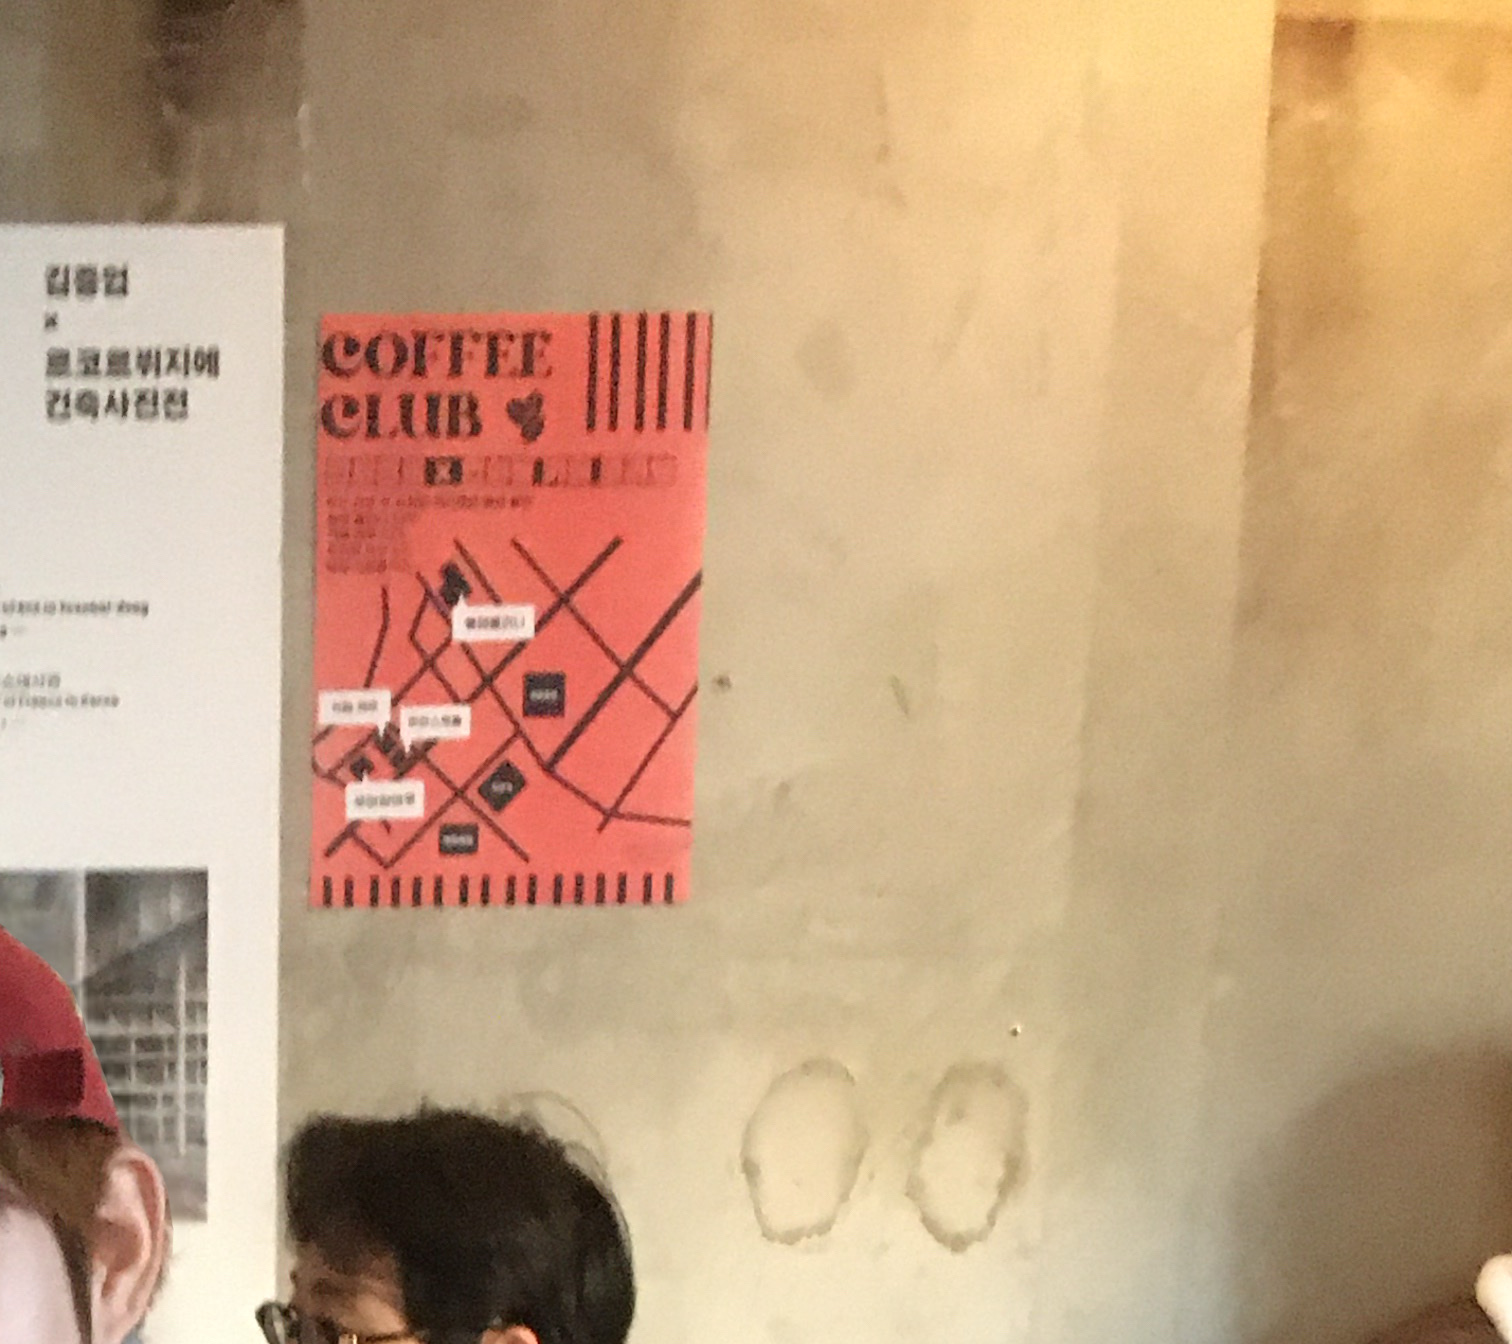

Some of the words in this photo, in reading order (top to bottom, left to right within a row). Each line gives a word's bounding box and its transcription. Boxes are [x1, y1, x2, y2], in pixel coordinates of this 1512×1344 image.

[321, 328, 552, 378] COFFEE
[45, 387, 190, 422] 건축사진전
[320, 392, 483, 439] CLUB
